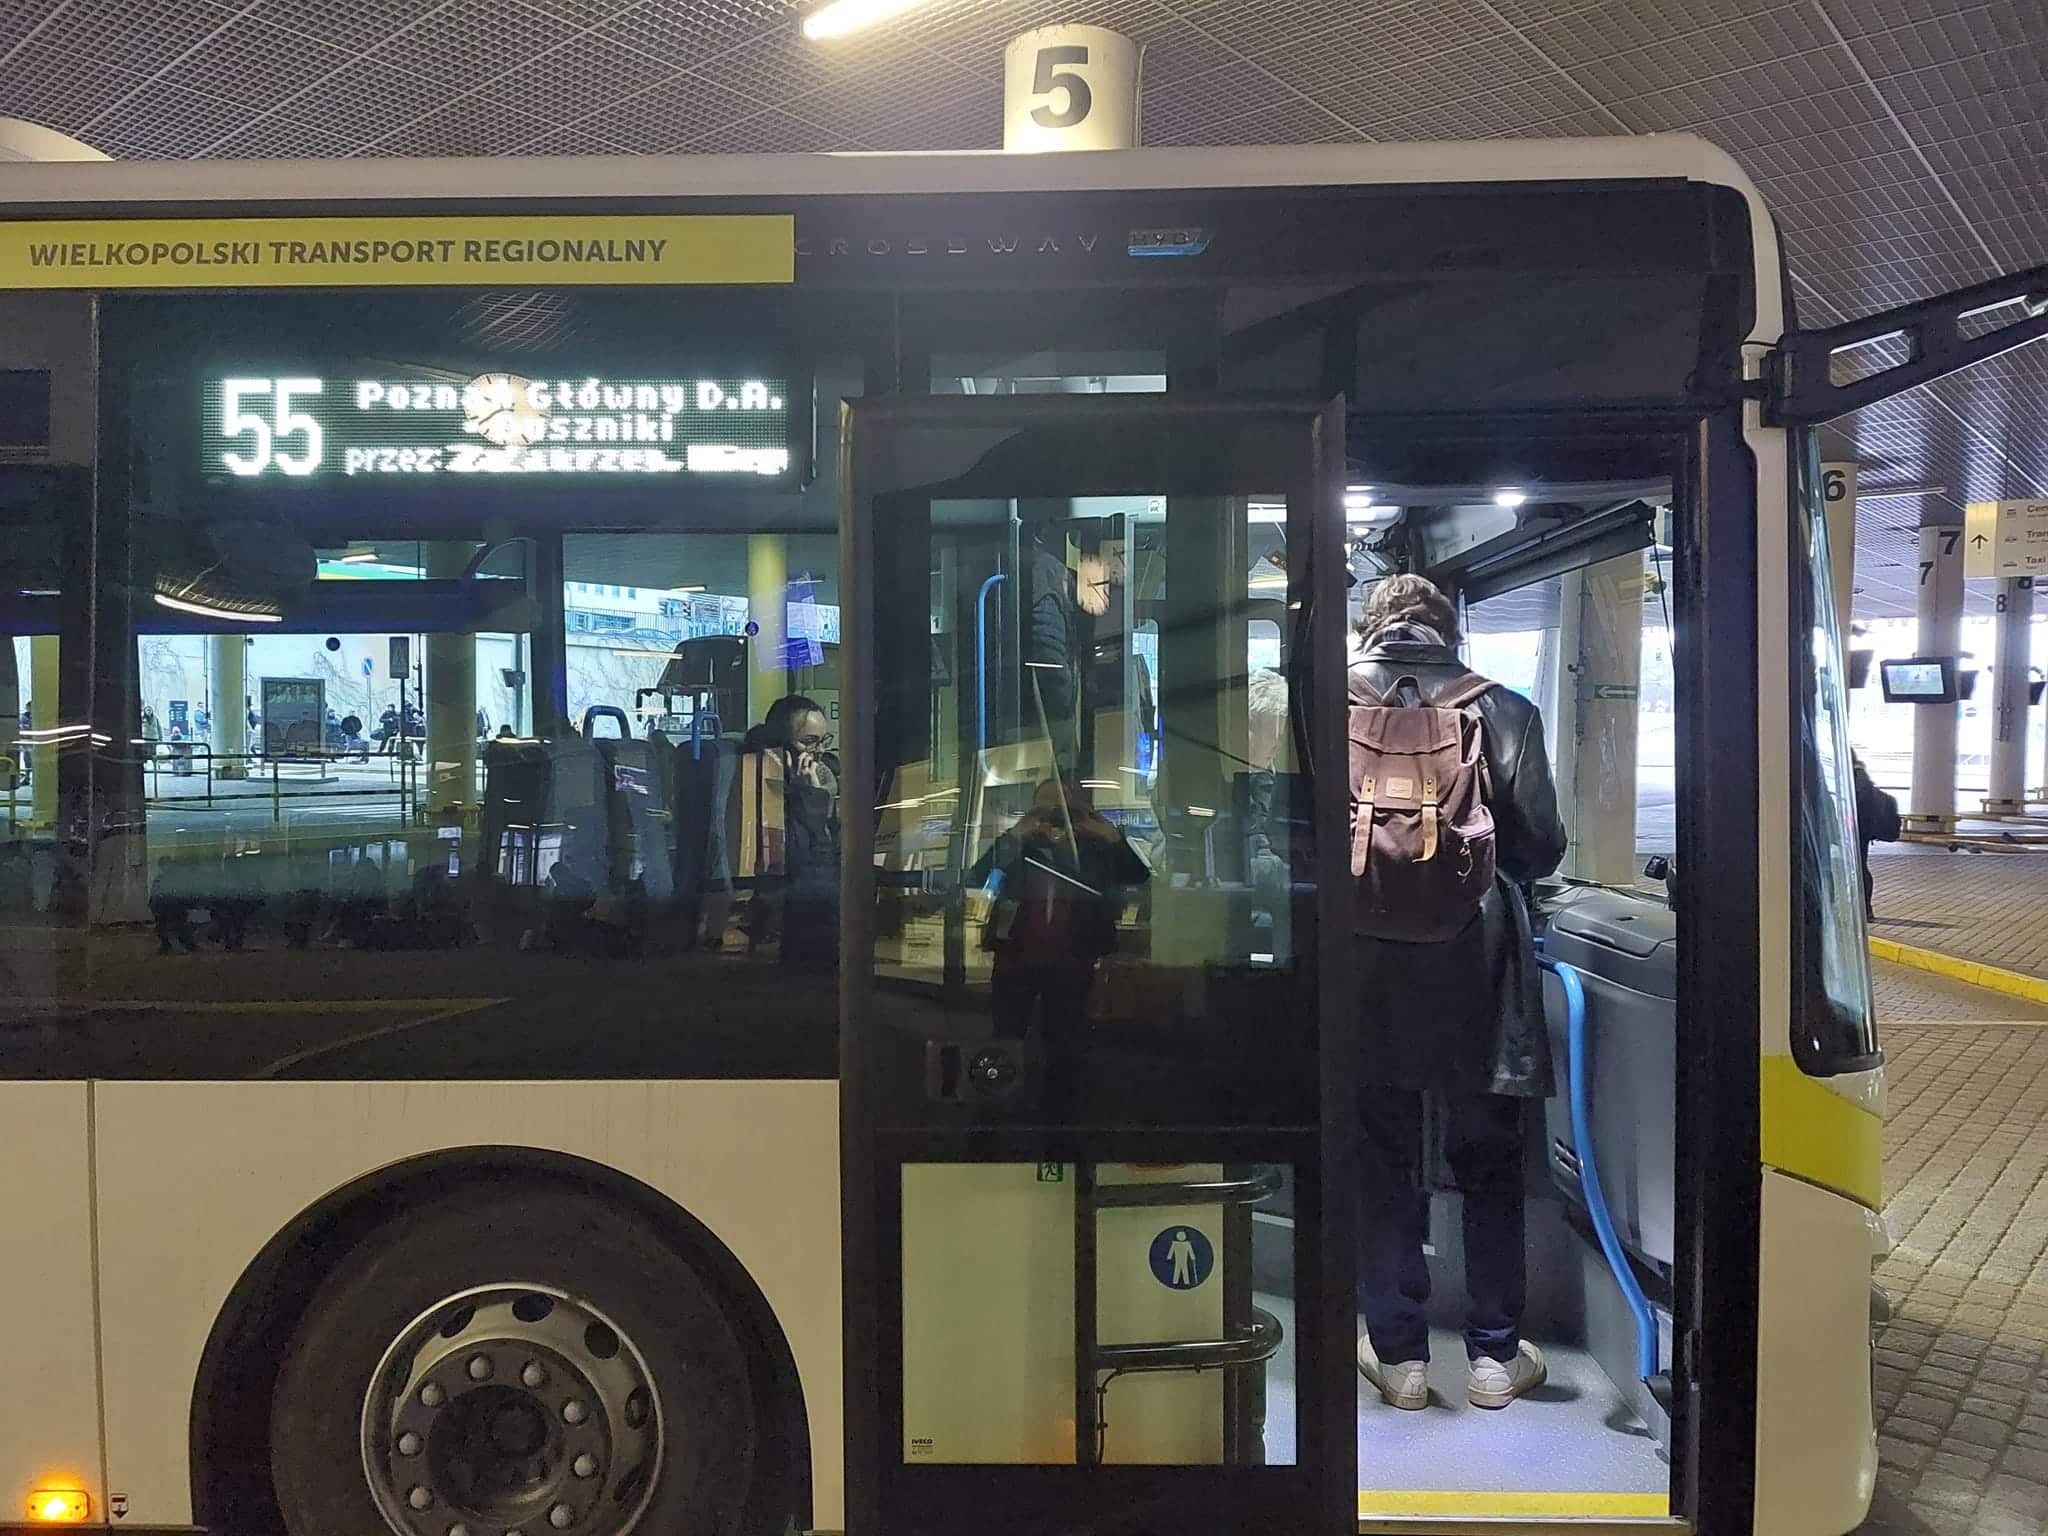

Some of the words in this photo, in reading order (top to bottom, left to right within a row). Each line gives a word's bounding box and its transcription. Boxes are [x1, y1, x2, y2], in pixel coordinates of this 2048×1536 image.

[1030, 45, 1092, 128] 5
[29, 242, 260, 266] WIELKOPOLSKI
[268, 240, 456, 264] TRANSPORT
[463, 239, 667, 263] REGIONALNY
[527, 377, 684, 415] Główny
[697, 382, 782, 411] D.A.
[222, 377, 322, 476] 55
[1822, 469, 1846, 502] 6
[1939, 531, 1961, 555] 7
[1919, 561, 1934, 586] 7
[1995, 594, 2007, 613] 8
